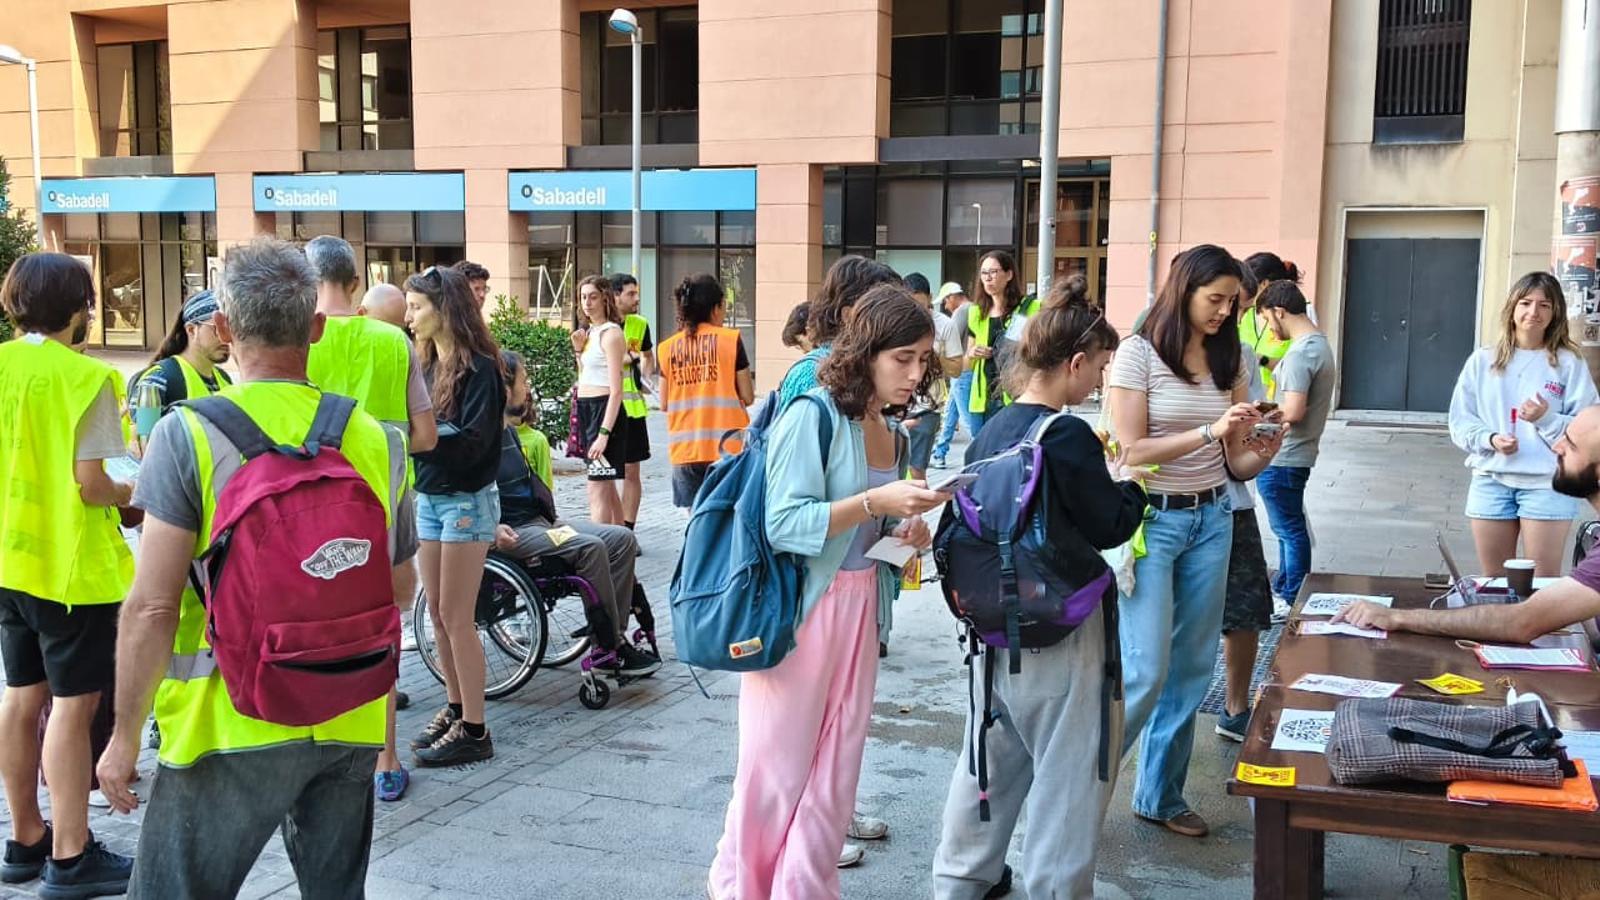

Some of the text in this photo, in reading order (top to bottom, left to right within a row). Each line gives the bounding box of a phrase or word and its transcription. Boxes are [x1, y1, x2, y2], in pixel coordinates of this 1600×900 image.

[57, 192, 110, 208] Sabadell
[275, 189, 337, 206] Sabadell
[533, 187, 606, 205] Sabadell
